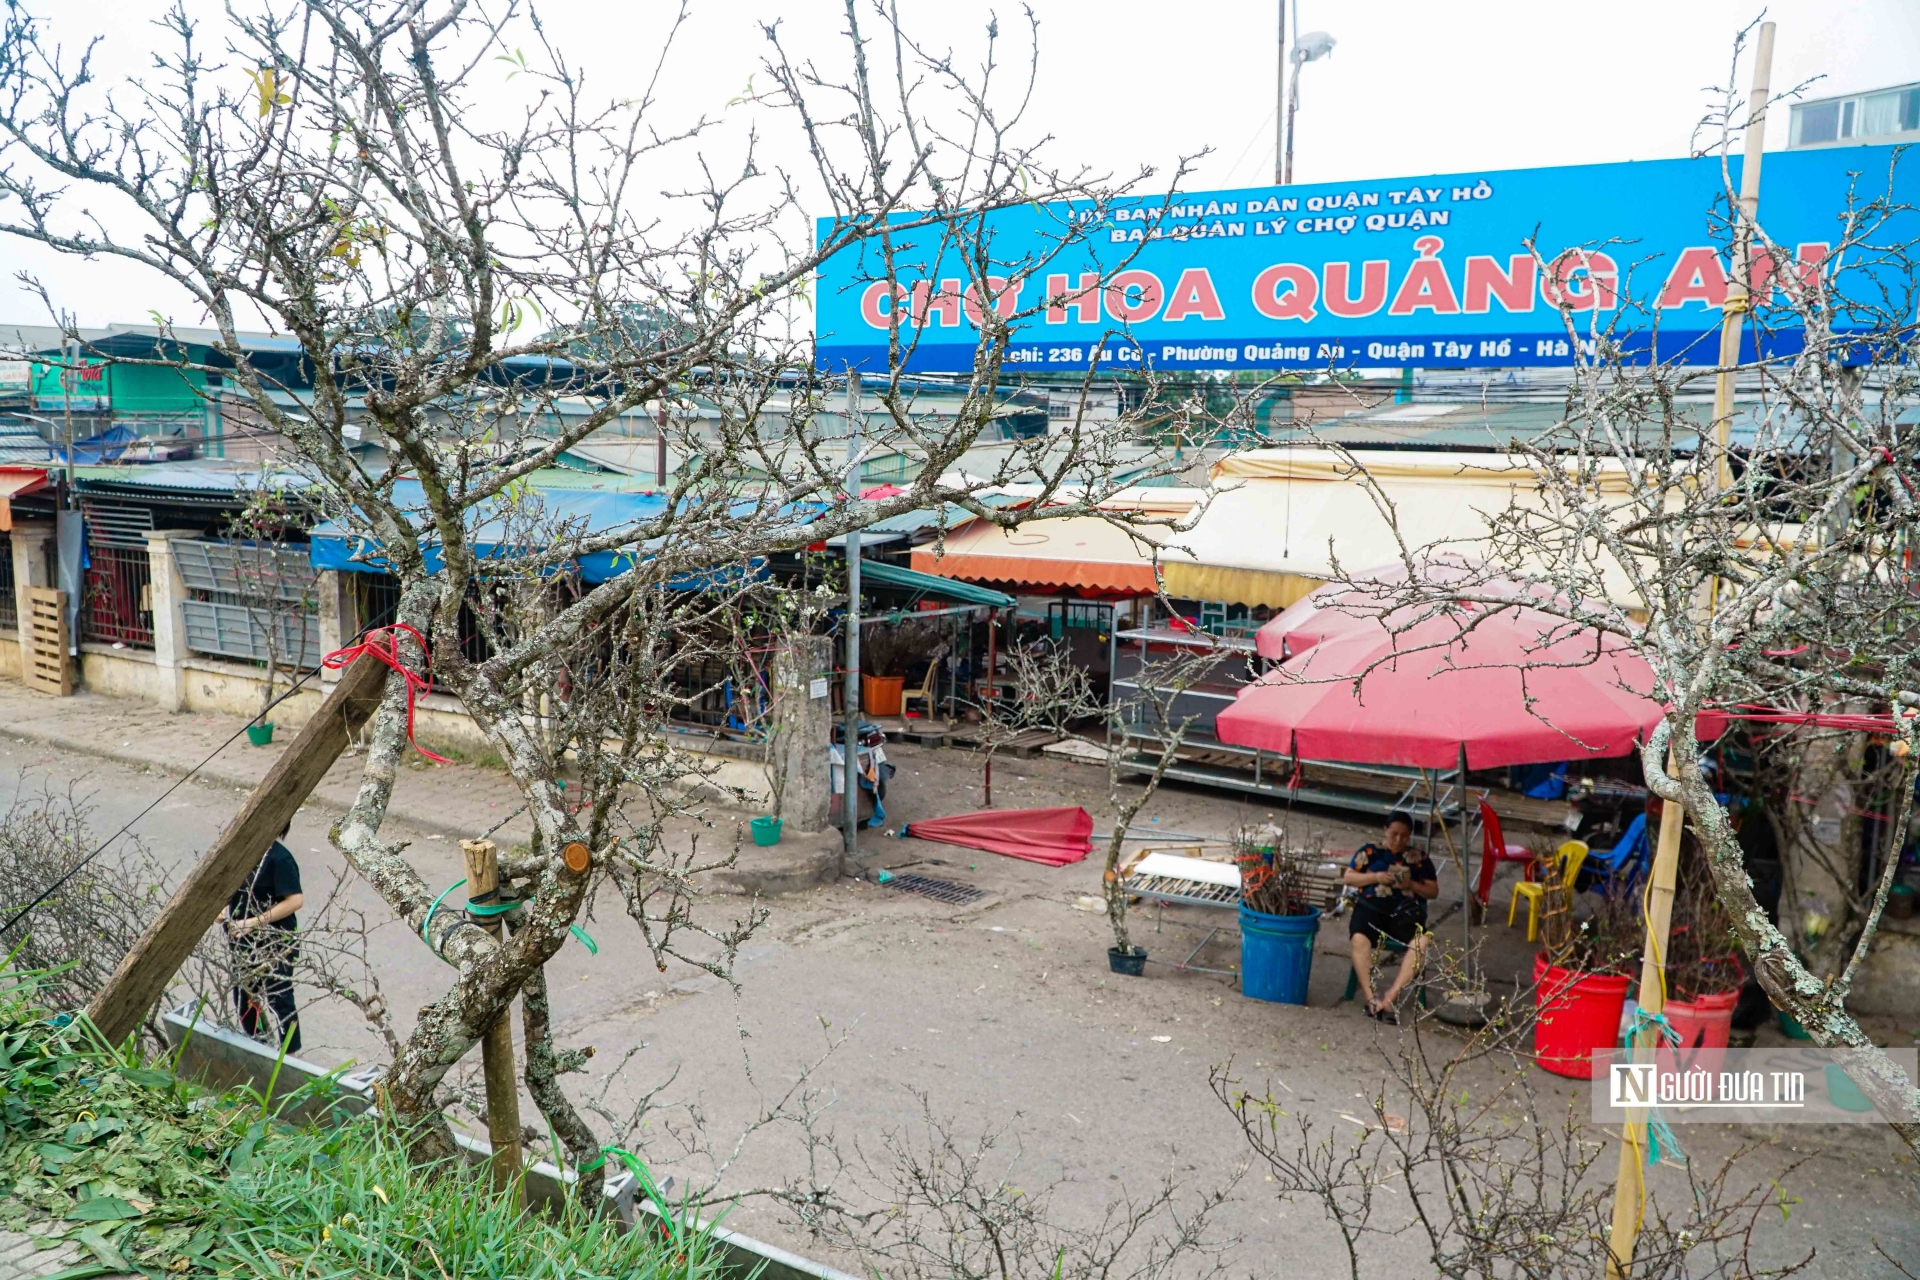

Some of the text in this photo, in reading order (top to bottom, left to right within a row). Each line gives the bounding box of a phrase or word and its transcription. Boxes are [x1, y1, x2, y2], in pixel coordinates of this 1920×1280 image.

[1115, 207, 1164, 222] BAN
[1171, 200, 1238, 218] NHÂN
[1247, 196, 1298, 214] DÂN
[1307, 191, 1379, 212] QUẬN
[1388, 187, 1443, 205] TÂY
[1452, 180, 1493, 201] HỒ
[1111, 209, 1449, 243] BAN QUẢN LÝ CHỢ QUẬN
[861, 235, 1830, 338] CHỢ HOA QUẢNG AN
[1048, 348, 1083, 363] 236
[1162, 345, 1238, 362] Phường
[1244, 343, 1310, 362] Quảng
[1316, 343, 1345, 359] An
[1367, 342, 1425, 361] Quận
[1432, 341, 1473, 360] Tây
[1536, 339, 1568, 357] Hà
